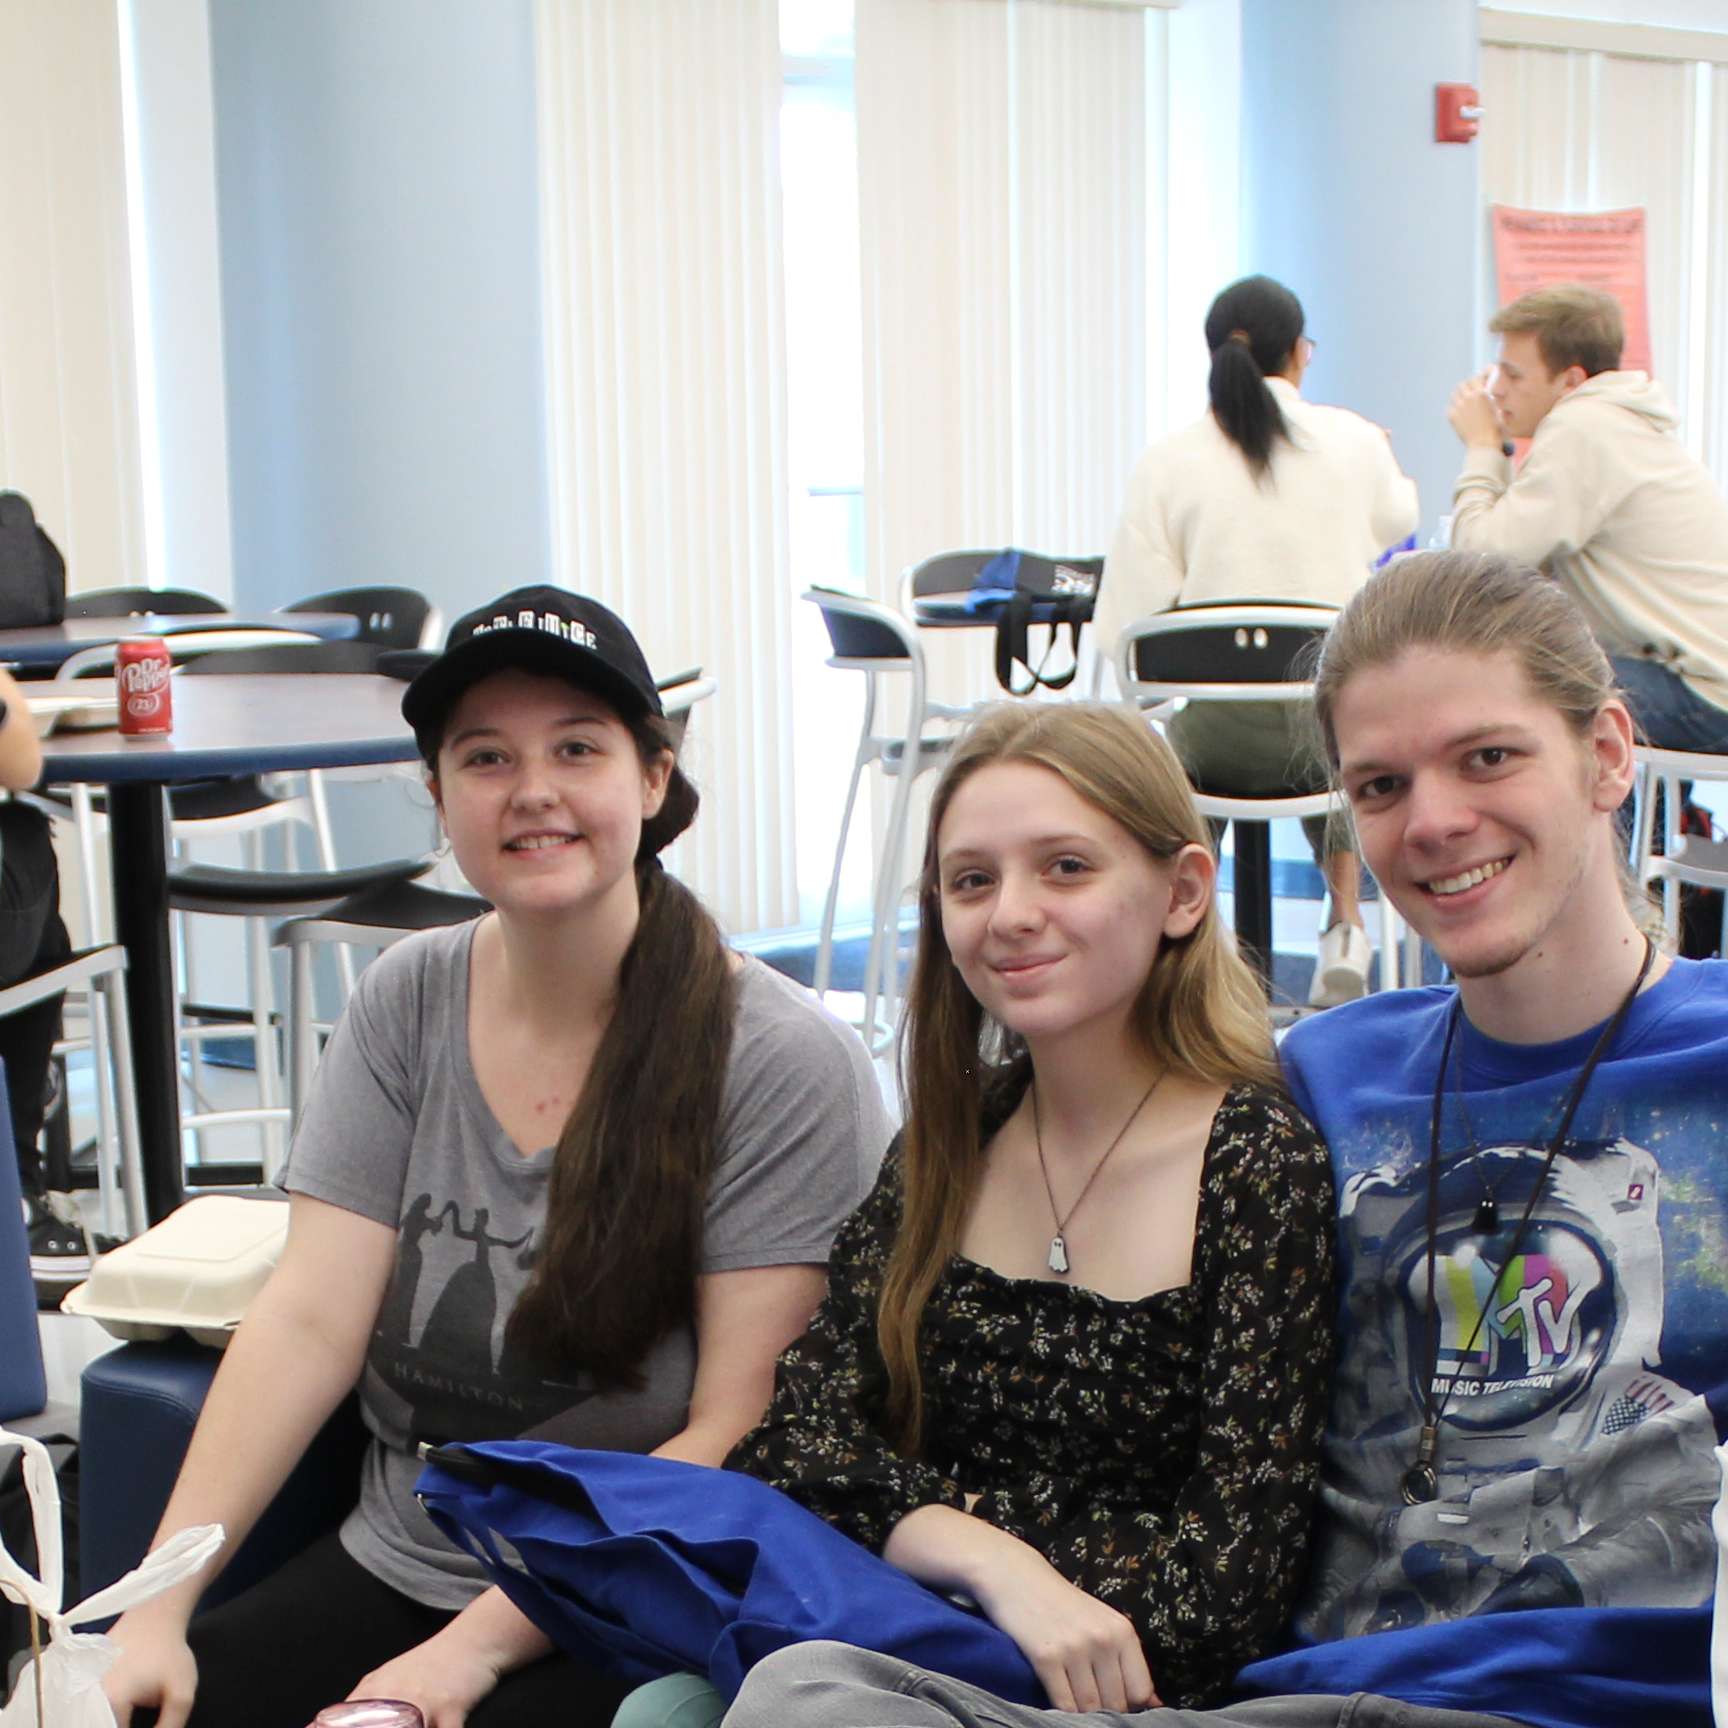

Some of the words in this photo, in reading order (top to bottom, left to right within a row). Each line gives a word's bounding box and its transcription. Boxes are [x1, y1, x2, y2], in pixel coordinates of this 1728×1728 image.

[141, 658, 162, 672] Dr
[393, 1362, 523, 1411] HAMILTON
[1430, 1377, 1481, 1397] MUSIC
